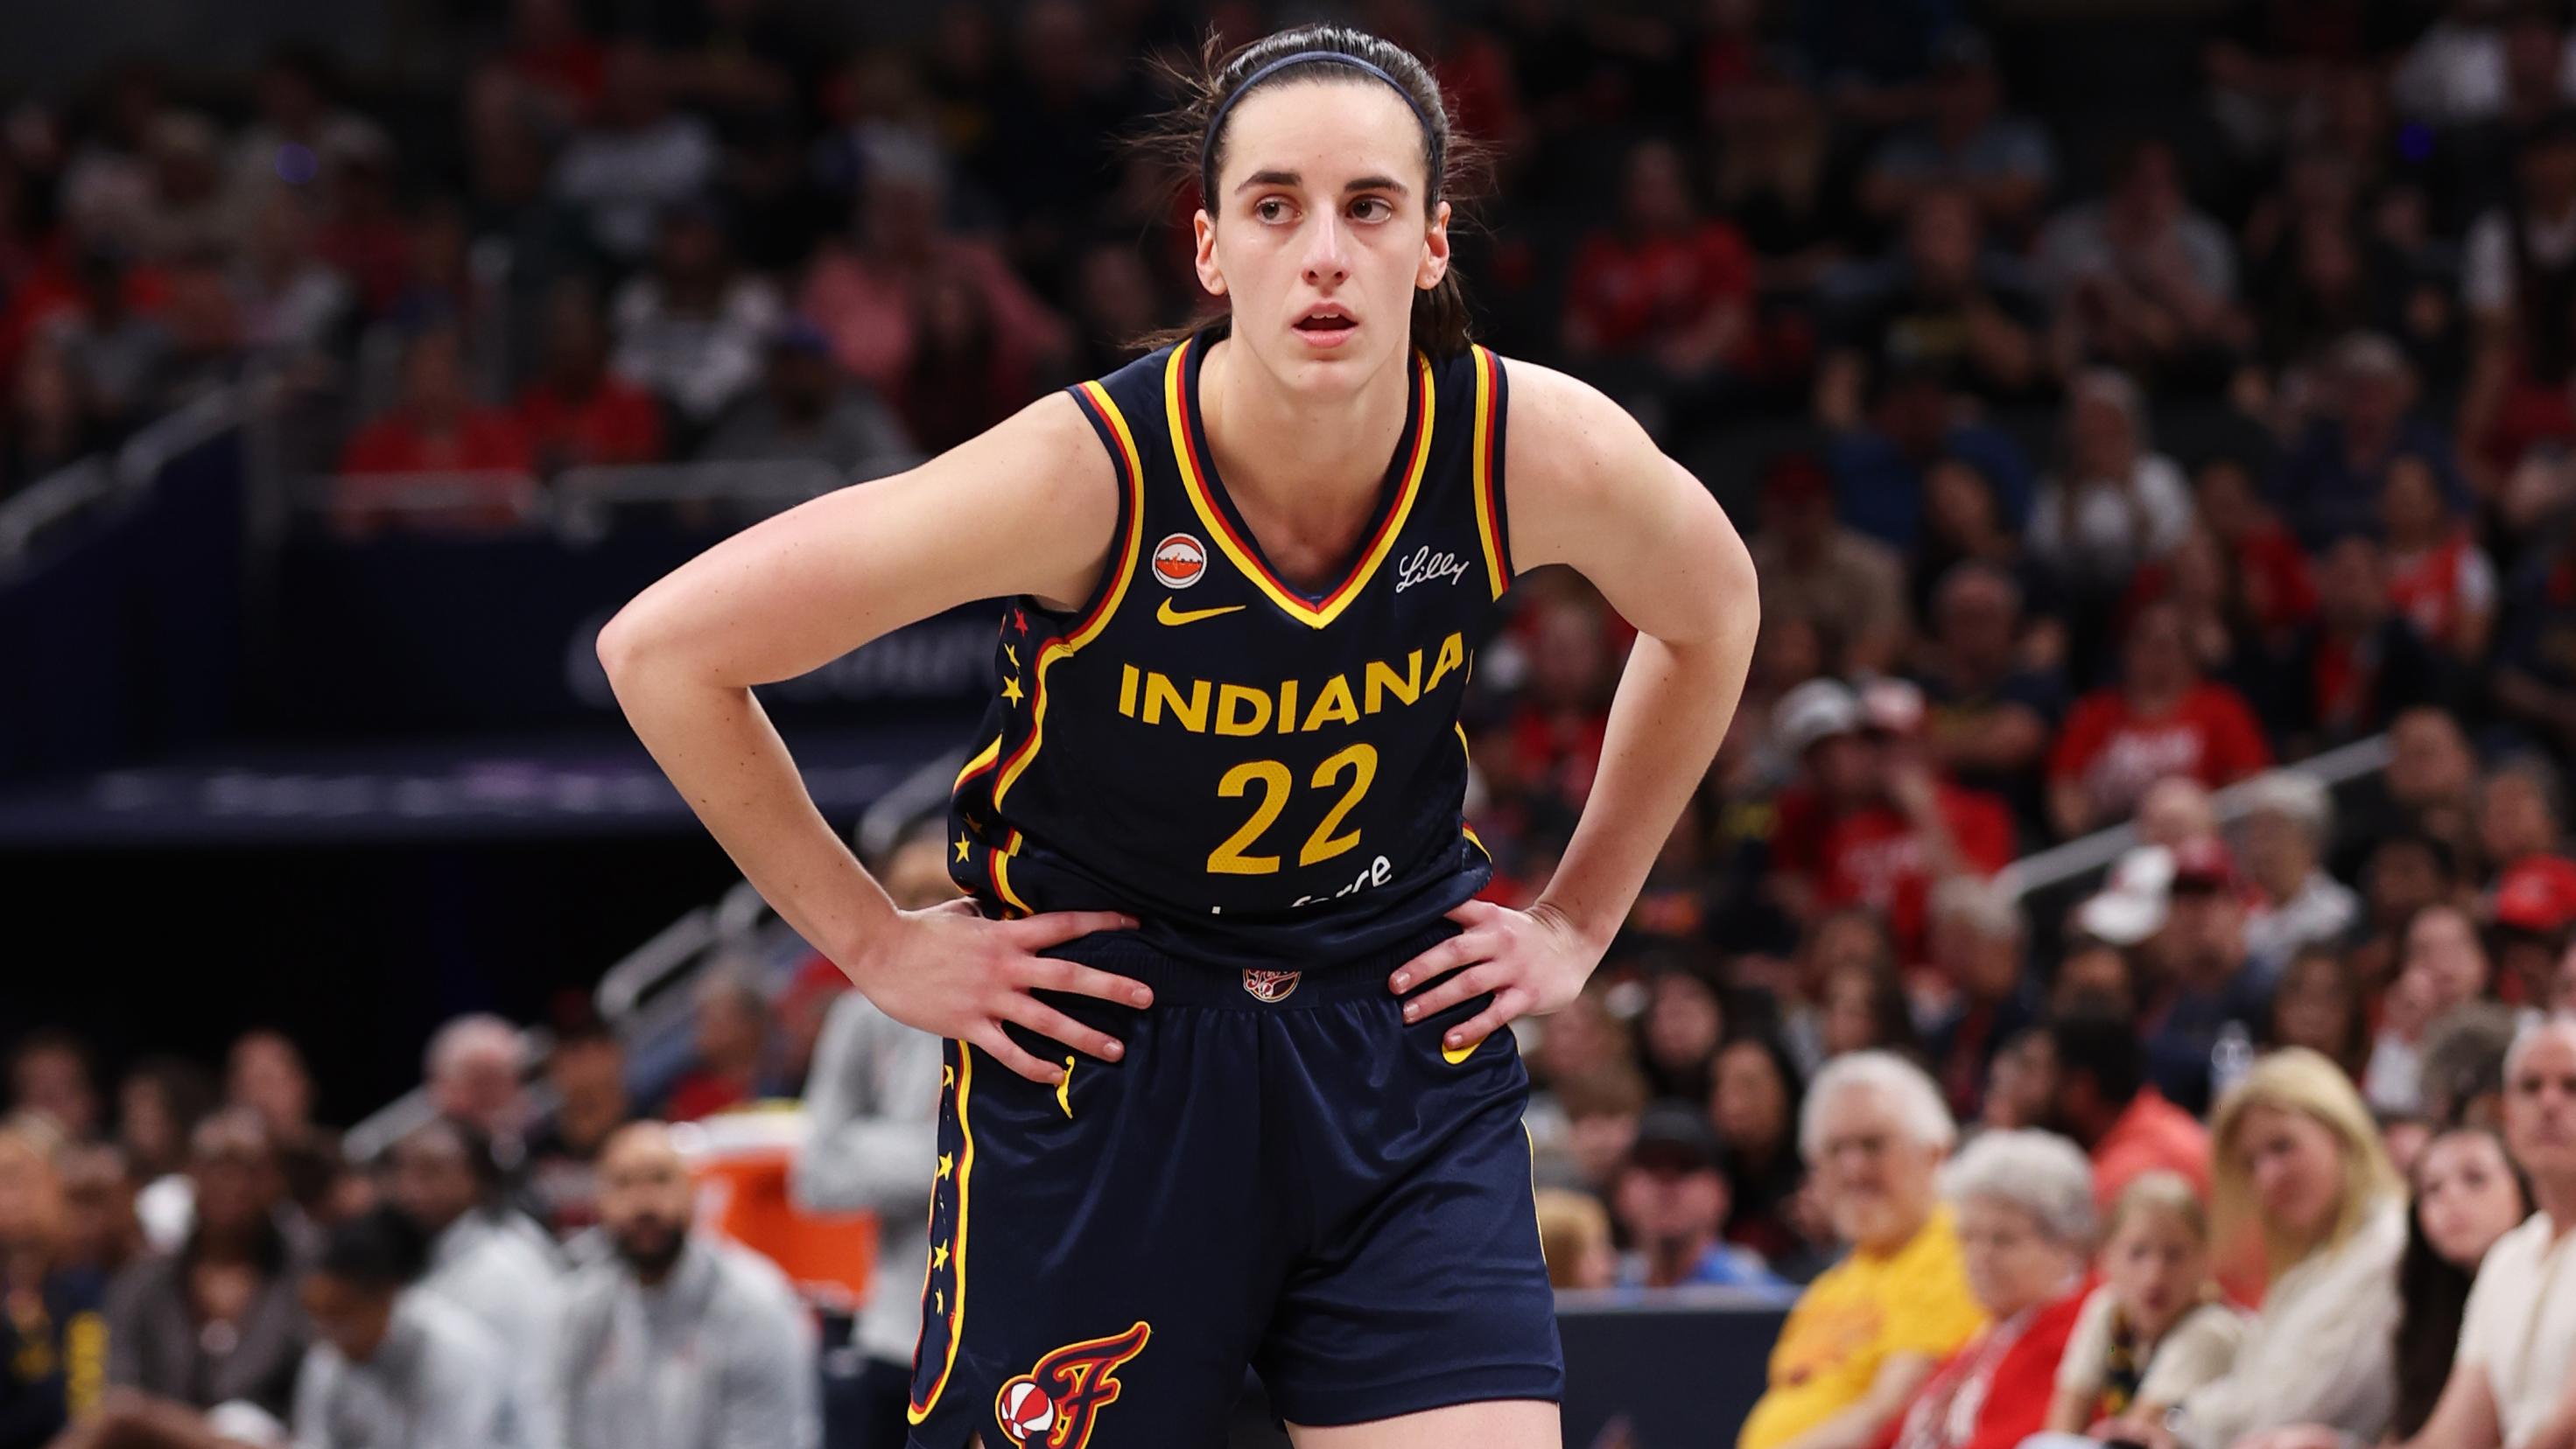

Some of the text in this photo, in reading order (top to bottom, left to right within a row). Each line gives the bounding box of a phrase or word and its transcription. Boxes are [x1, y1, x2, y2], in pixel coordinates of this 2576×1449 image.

[1395, 545, 1470, 593] Lilly
[1119, 632, 1474, 737] INDIANA
[1206, 743, 1379, 875] 22
